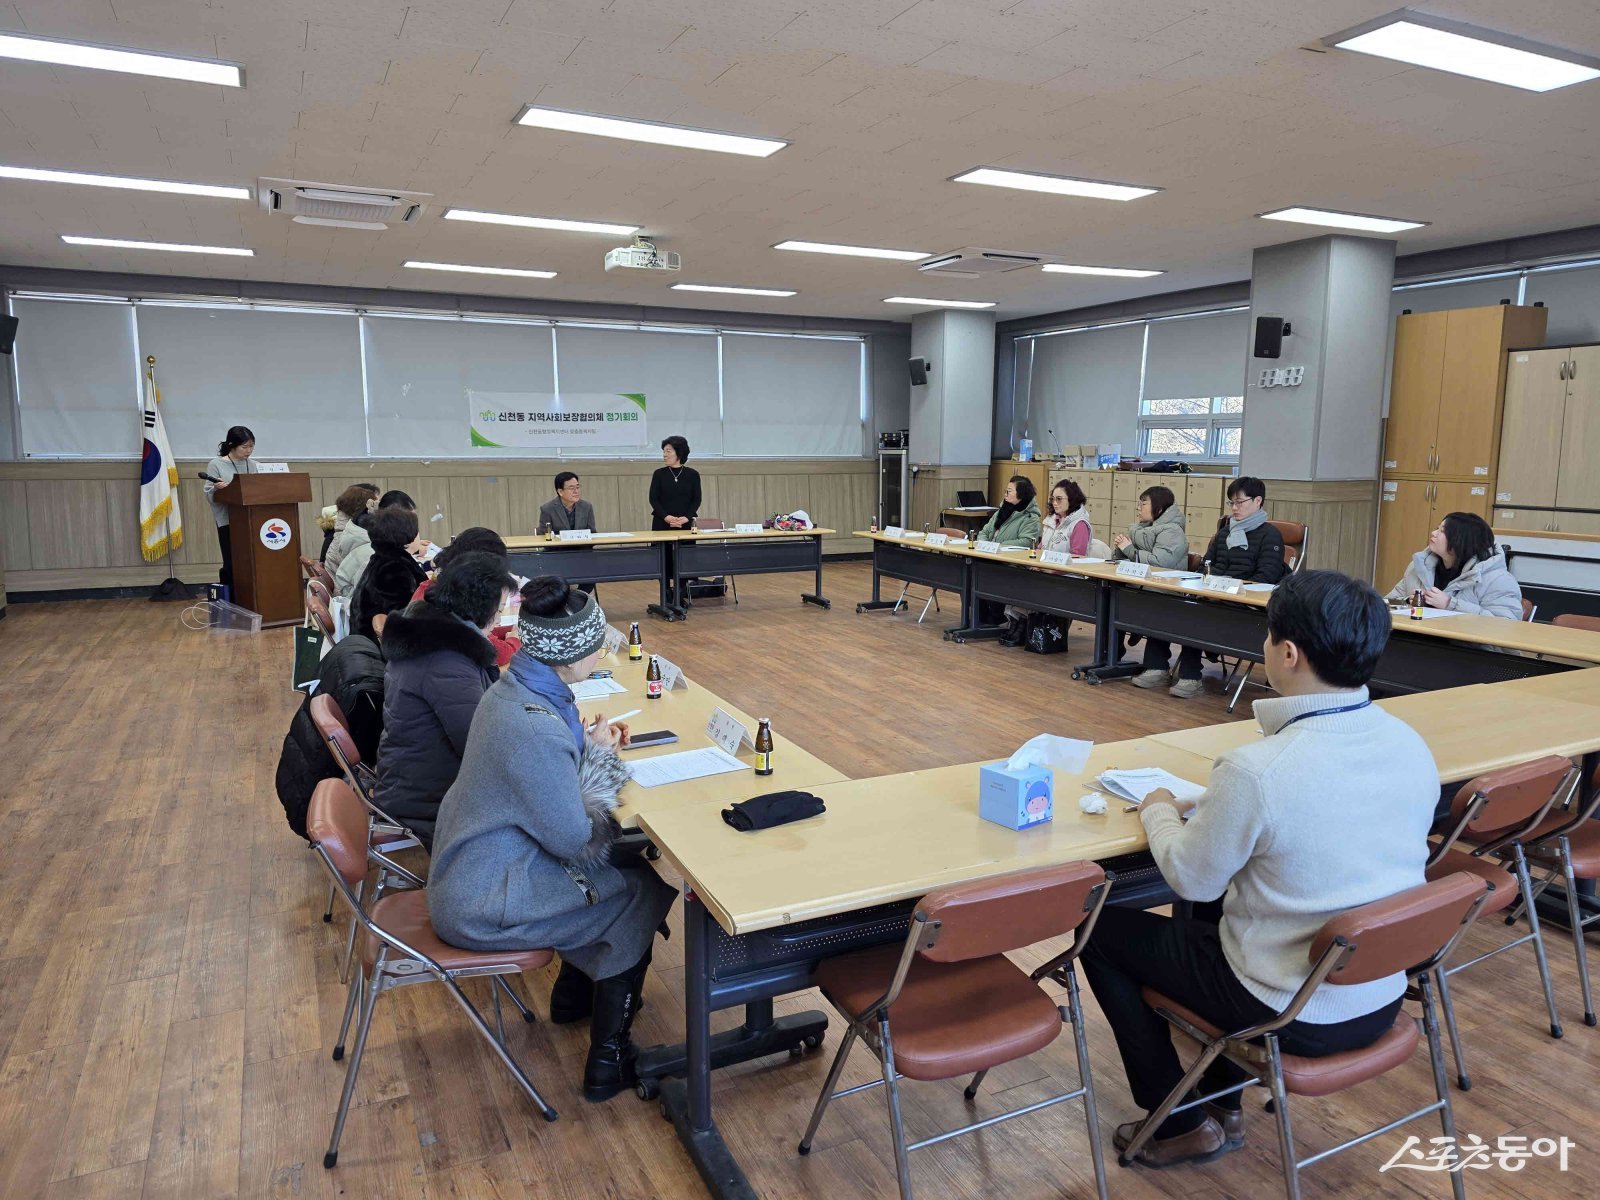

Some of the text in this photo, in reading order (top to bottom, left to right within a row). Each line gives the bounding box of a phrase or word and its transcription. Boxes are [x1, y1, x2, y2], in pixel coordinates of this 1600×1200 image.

[498, 412, 639, 422] 신천동 지역사회보장협의체 정기회의
